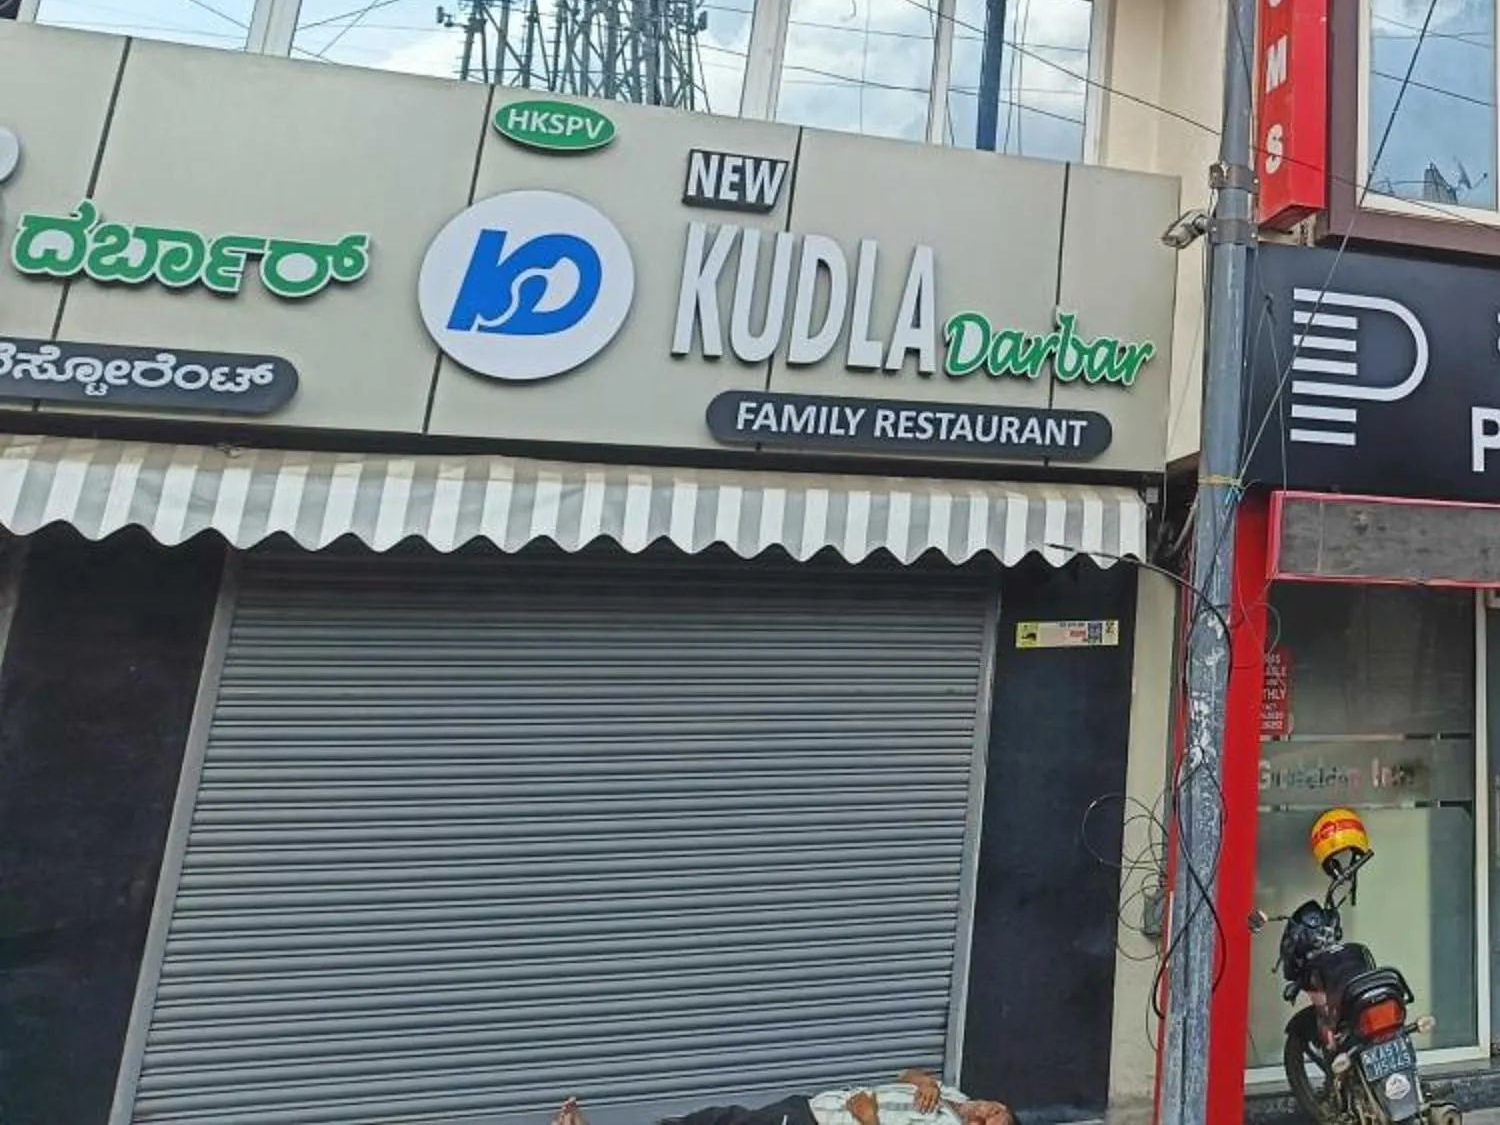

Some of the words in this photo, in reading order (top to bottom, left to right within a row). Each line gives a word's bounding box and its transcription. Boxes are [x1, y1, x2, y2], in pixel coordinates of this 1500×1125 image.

[506, 108, 605, 140] HKSPV
[686, 152, 786, 206] NEW
[671, 221, 938, 375] KUDLA
[943, 305, 1156, 386] Darbar
[736, 400, 866, 437] FAMILY
[873, 407, 1088, 448] RESTAURANT
